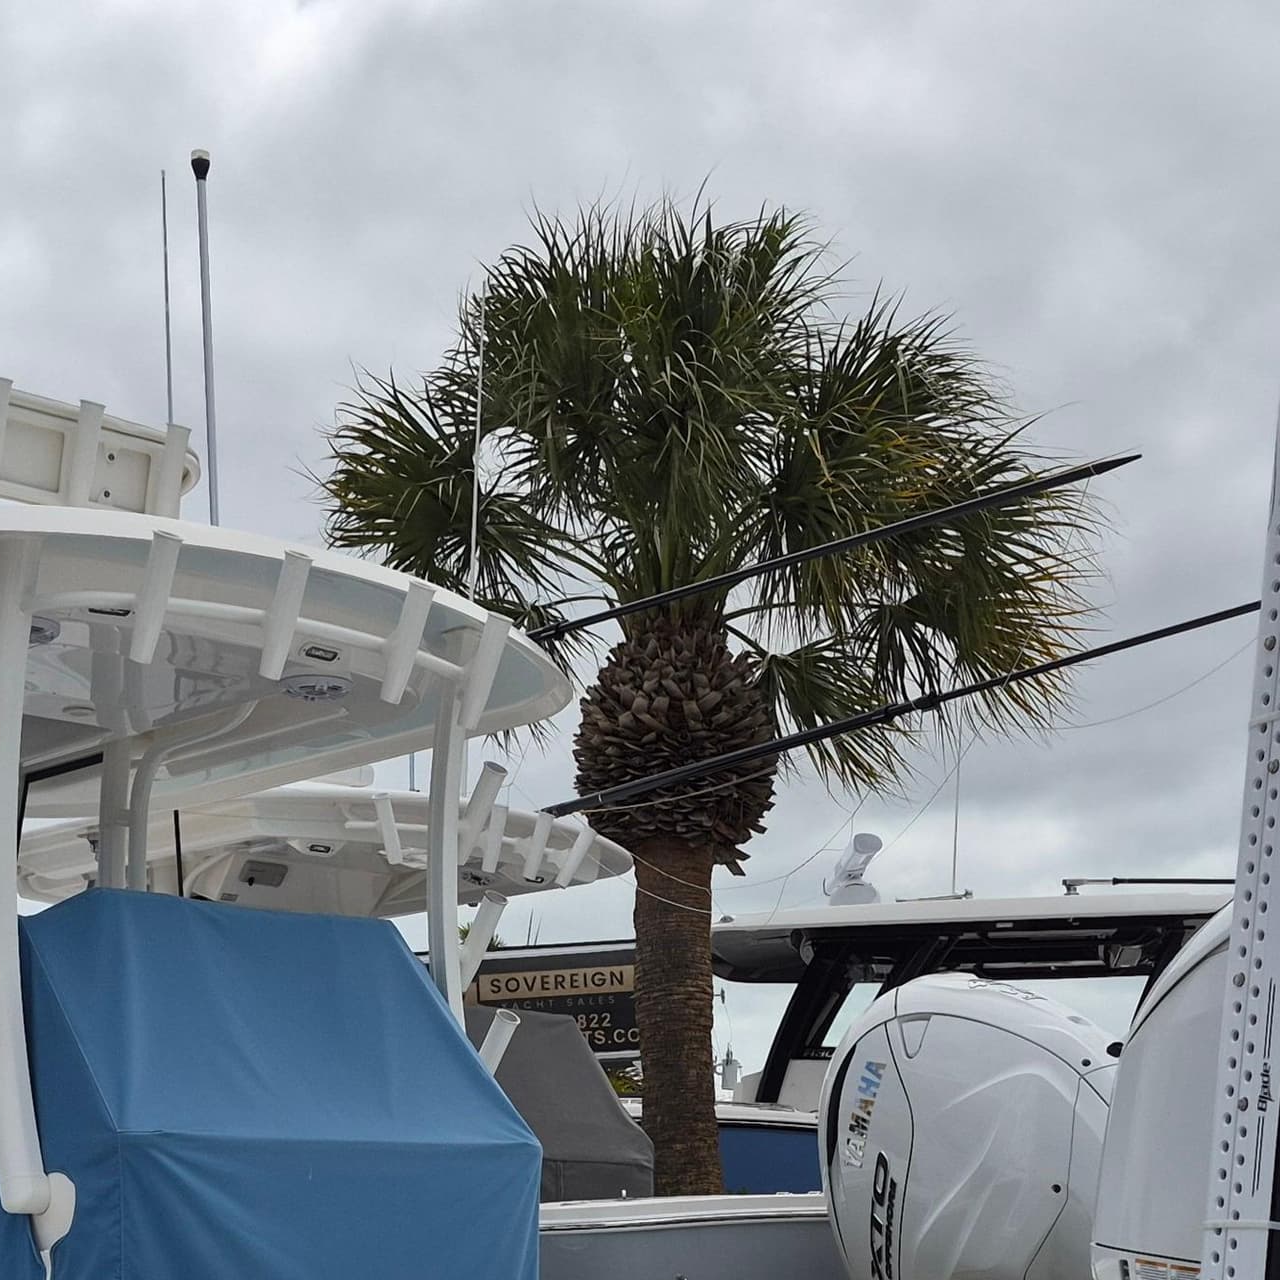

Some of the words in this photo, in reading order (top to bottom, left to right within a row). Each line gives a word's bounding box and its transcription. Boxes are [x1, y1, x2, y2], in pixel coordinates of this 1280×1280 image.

[489, 970, 625, 995] SOVEREIGN
[566, 996, 616, 1007] SALES
[577, 1013, 612, 1028] 822
[582, 1028, 640, 1045] TS.CO
[1257, 1062, 1275, 1112] Blade
[844, 1060, 887, 1170] YAMAHA
